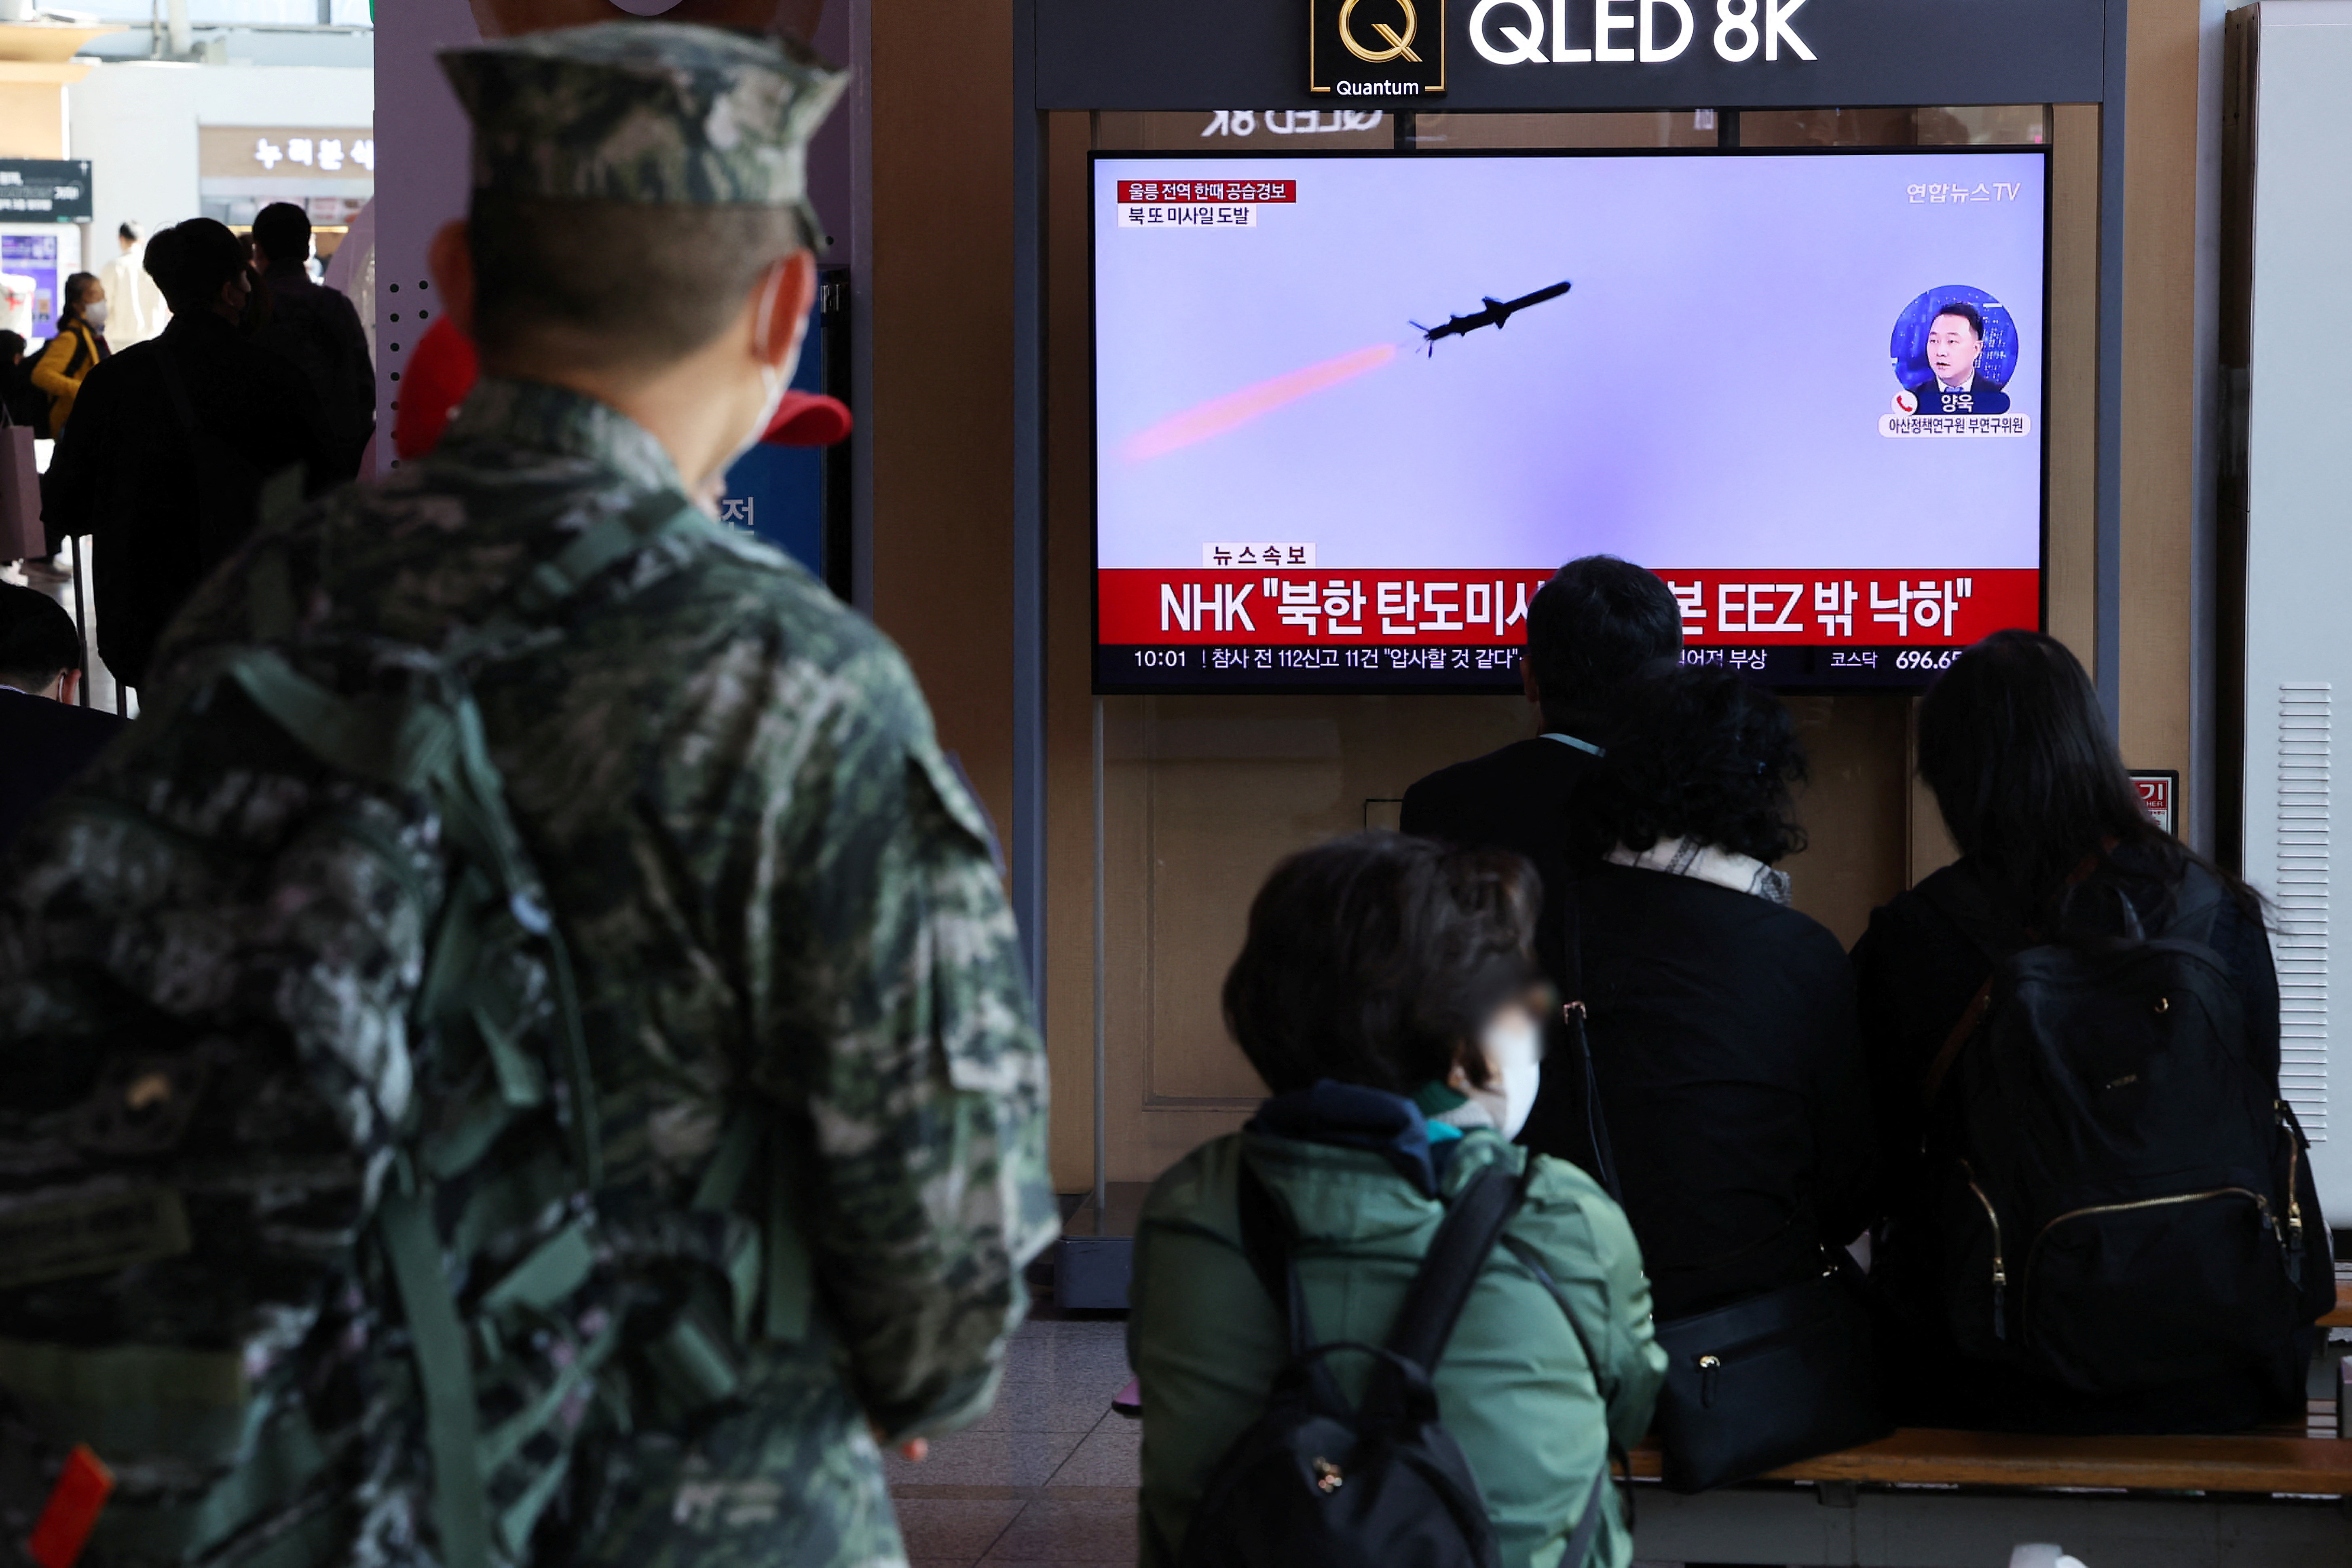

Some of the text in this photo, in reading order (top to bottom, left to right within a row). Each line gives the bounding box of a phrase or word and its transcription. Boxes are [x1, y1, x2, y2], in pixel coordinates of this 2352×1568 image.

[1339, 0, 1423, 63] Q
[1470, 0, 1818, 64] QLED 8K
[1337, 80, 1419, 95] Quantum
[1129, 183, 1287, 201] 울릉 전역 한때 공습경보
[1129, 207, 1249, 225] 북 또 미사일 도발
[1941, 394, 1974, 413] 양욱
[1889, 418, 2022, 434] 아산정책연구원 부연구위원
[1161, 583, 1256, 631] NHK
[1262, 577, 1367, 636] "북한
[1718, 583, 1804, 632] EEZ
[1814, 580, 1859, 637] 밖
[1870, 577, 1972, 637] 낙하"
[1135, 650, 1186, 667] 10:01
[1212, 649, 1250, 669] 참사
[1255, 649, 1272, 668] 전
[1278, 649, 1340, 669] 112신고
[1345, 649, 1379, 669] 11건
[1384, 648, 1446, 669] "압사할
[1452, 649, 1469, 669] 것
[1729, 649, 1769, 670] 부상
[1830, 650, 1879, 669] 코스닥
